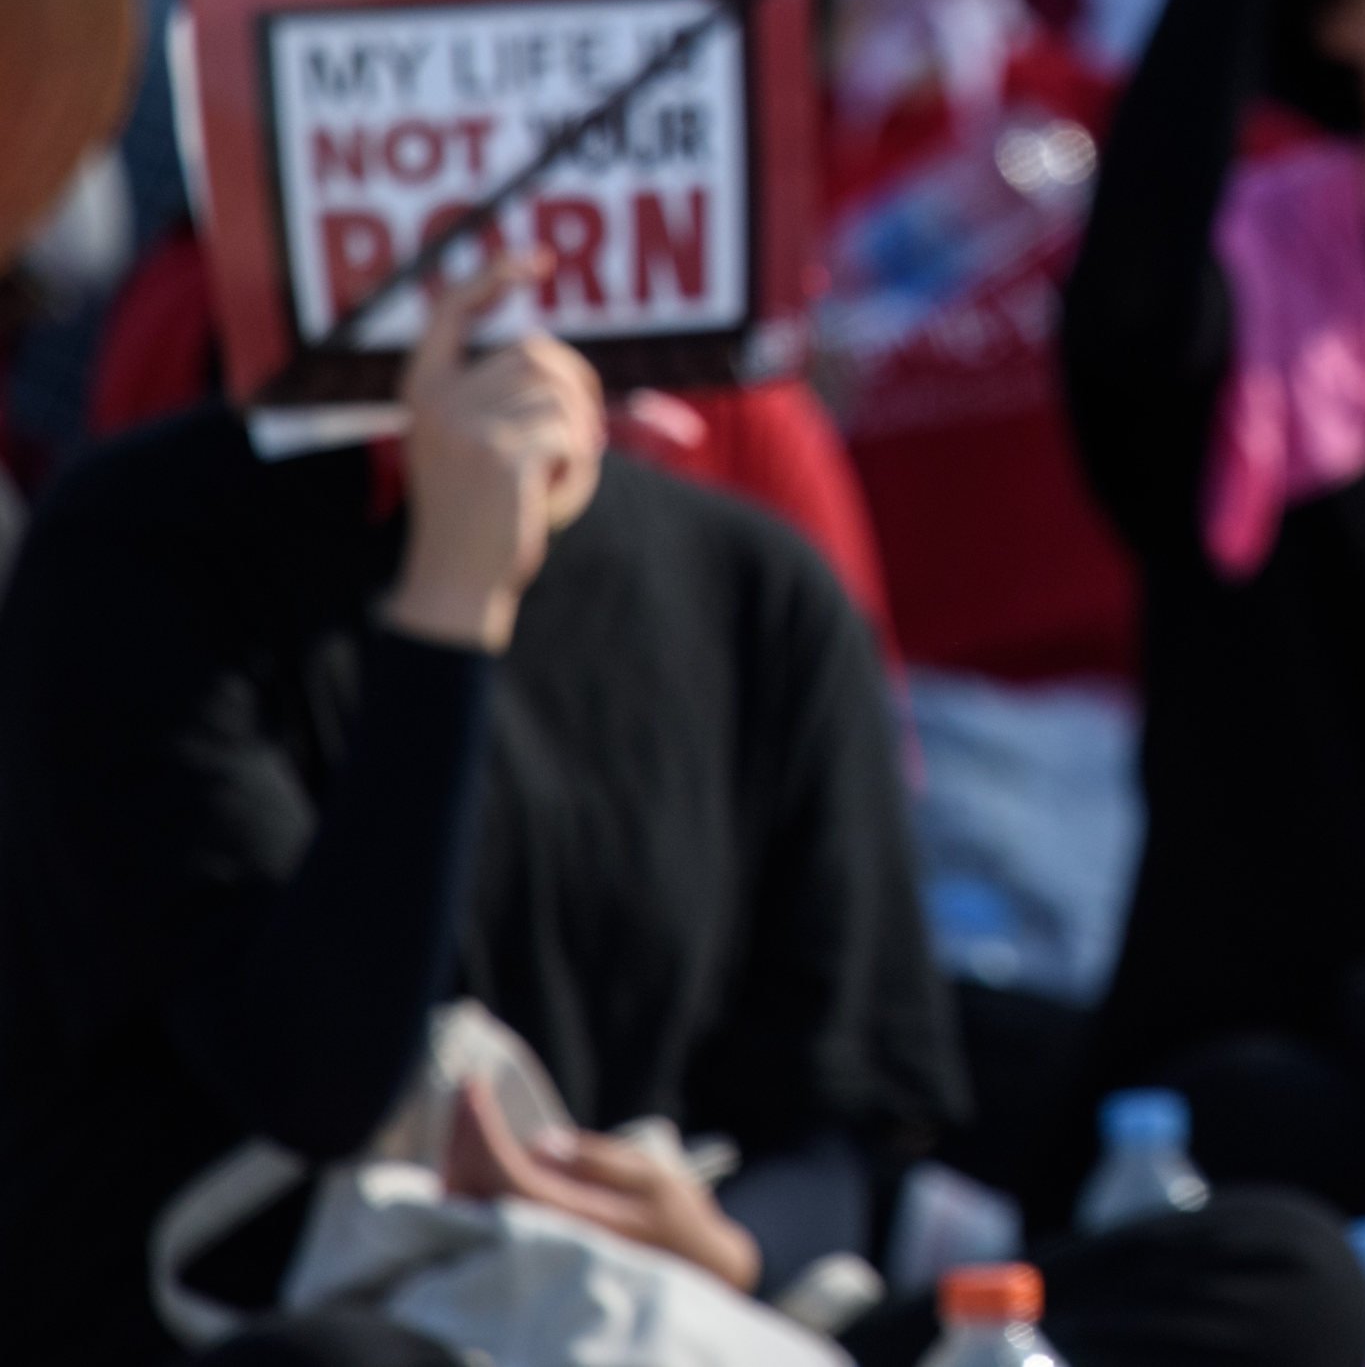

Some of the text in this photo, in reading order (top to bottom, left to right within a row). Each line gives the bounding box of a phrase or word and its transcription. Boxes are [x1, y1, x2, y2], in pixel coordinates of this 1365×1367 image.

[306, 41, 434, 100] MY
[450, 36, 602, 96] LIFE
[312, 116, 500, 186] NOT
[318, 188, 712, 318] PORN
